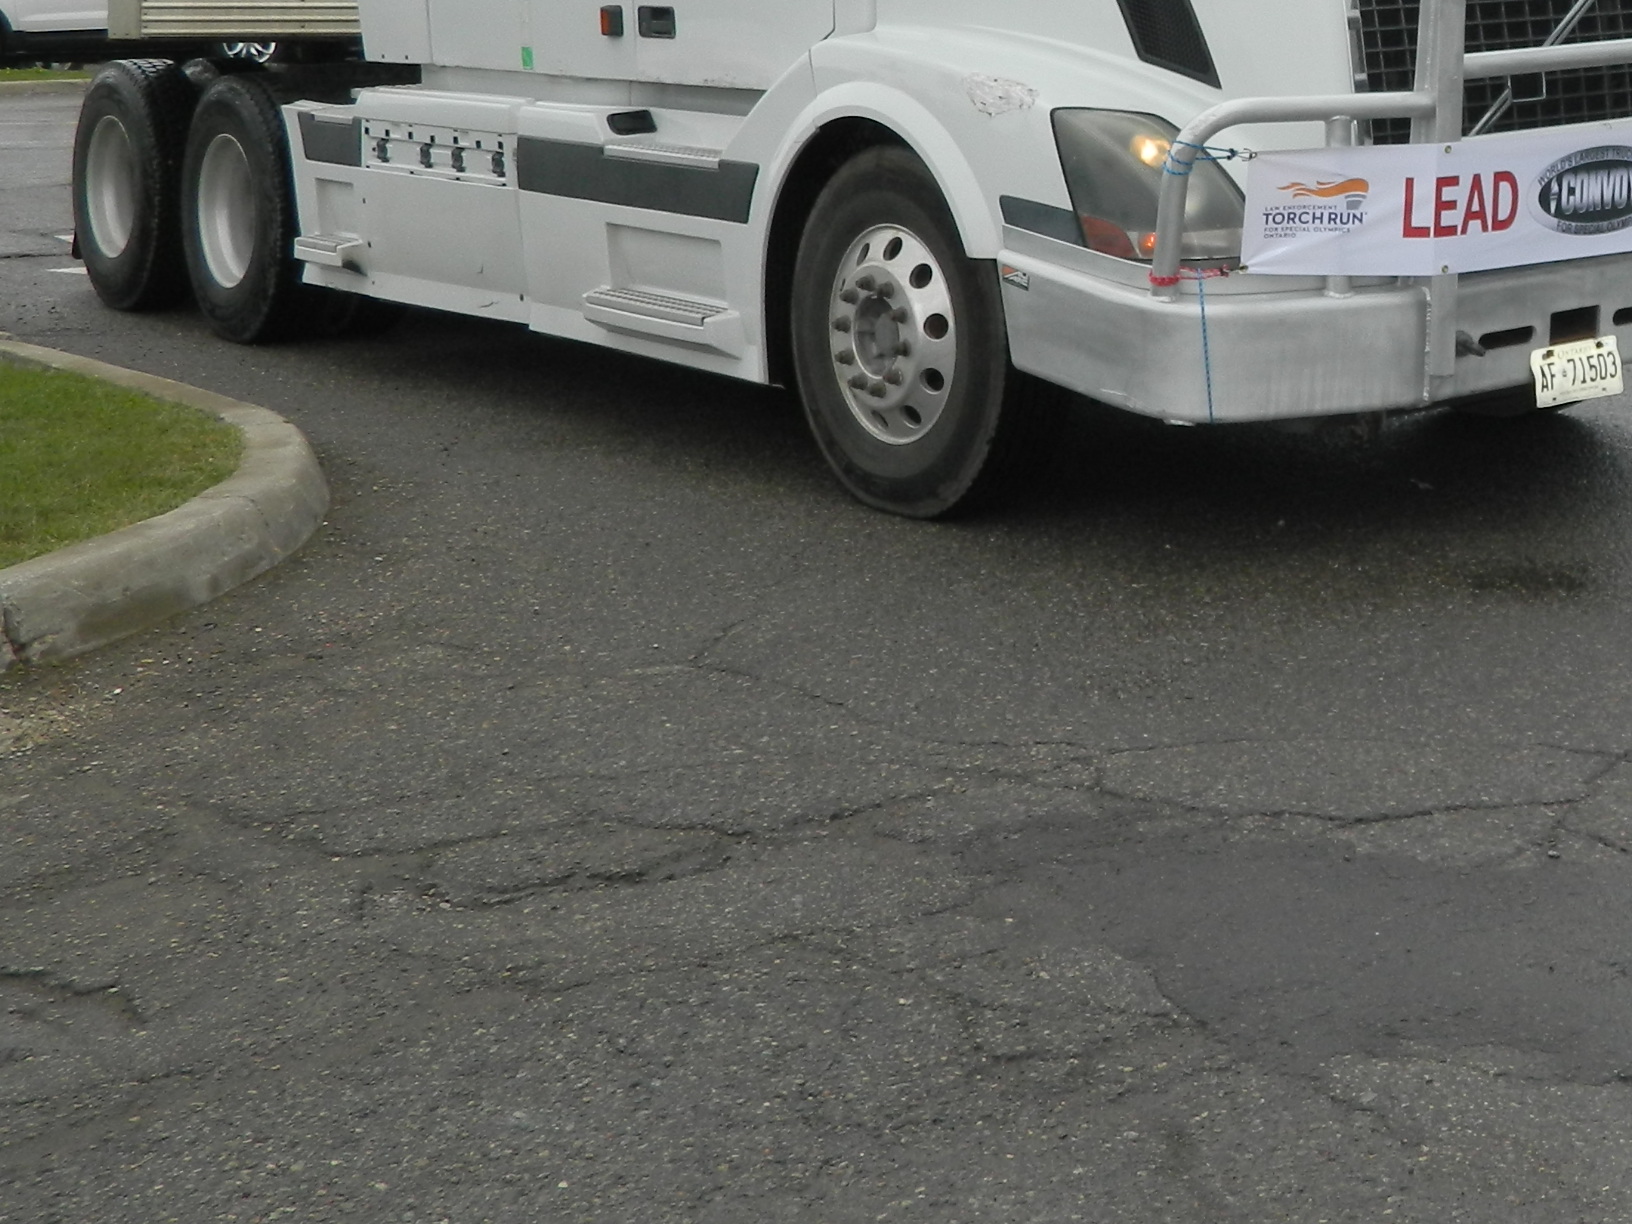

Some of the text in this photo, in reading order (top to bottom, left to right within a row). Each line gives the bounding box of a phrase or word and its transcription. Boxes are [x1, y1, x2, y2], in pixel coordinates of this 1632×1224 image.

[1282, 204, 1338, 212] ENFORCEMENT
[1402, 170, 1519, 239] LEAD
[1262, 211, 1364, 226] TORCH RUN
[1313, 226, 1351, 234] OLYMPICS
[1556, 220, 1572, 233] FOR
[1539, 351, 1618, 393] AF 71503
